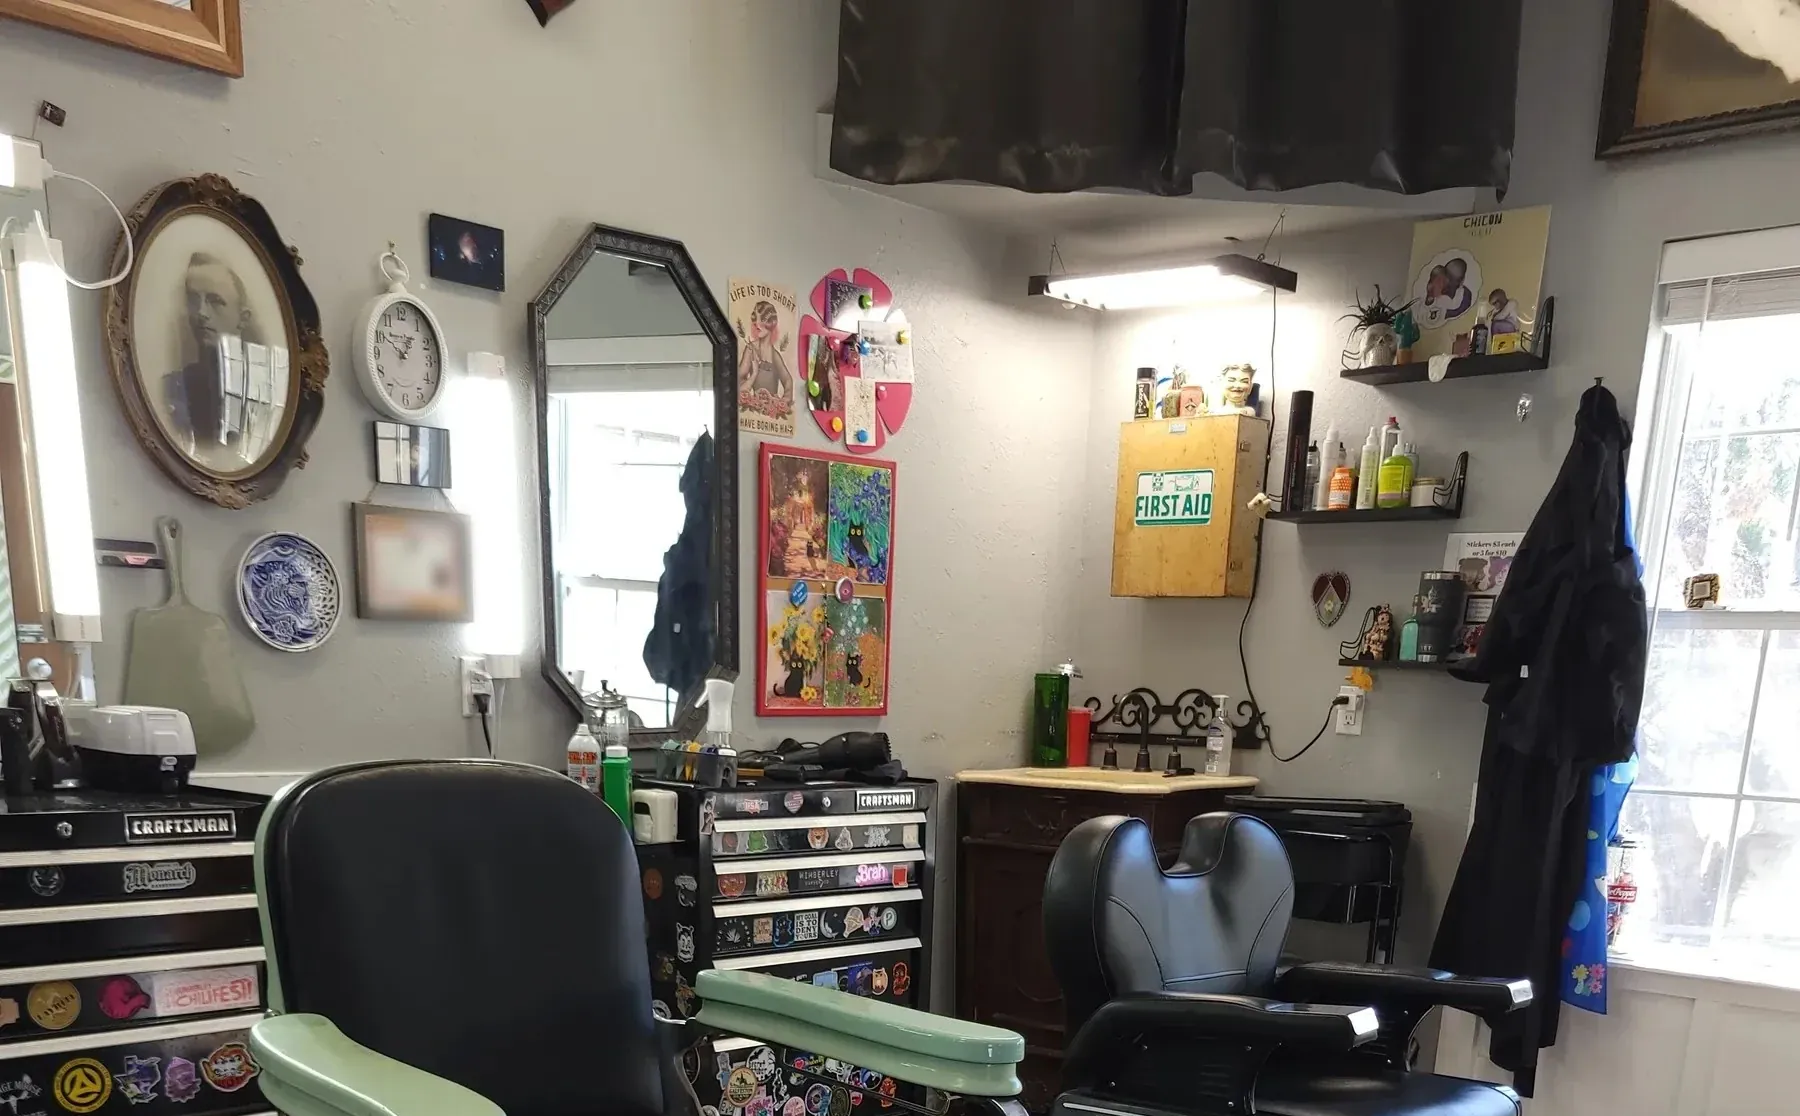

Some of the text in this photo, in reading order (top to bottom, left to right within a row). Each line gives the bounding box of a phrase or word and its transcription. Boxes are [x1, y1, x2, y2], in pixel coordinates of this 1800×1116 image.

[1463, 212, 1503, 228] CHICON
[730, 284, 796, 313] LIFE IS TOO SHORT
[383, 313, 392, 328] 11
[396, 306, 406, 321] 12
[415, 319, 419, 332] 1
[375, 330, 385, 344] 10
[422, 337, 430, 351] 2
[373, 345, 381, 360] 9
[425, 355, 433, 368] 3
[377, 364, 385, 379] 8
[423, 372, 431, 385] 4
[386, 382, 394, 397] 7
[416, 387, 424, 401] 5
[402, 393, 410, 407] 6
[740, 418, 756, 430] HAVE
[757, 420, 779, 433] BORING
[1135, 493, 1212, 517] FIRST AID
[860, 795, 912, 807] CRAFTSMAN
[132, 818, 230, 835] CRAFTSMAN
[796, 926, 817, 934] DENY
